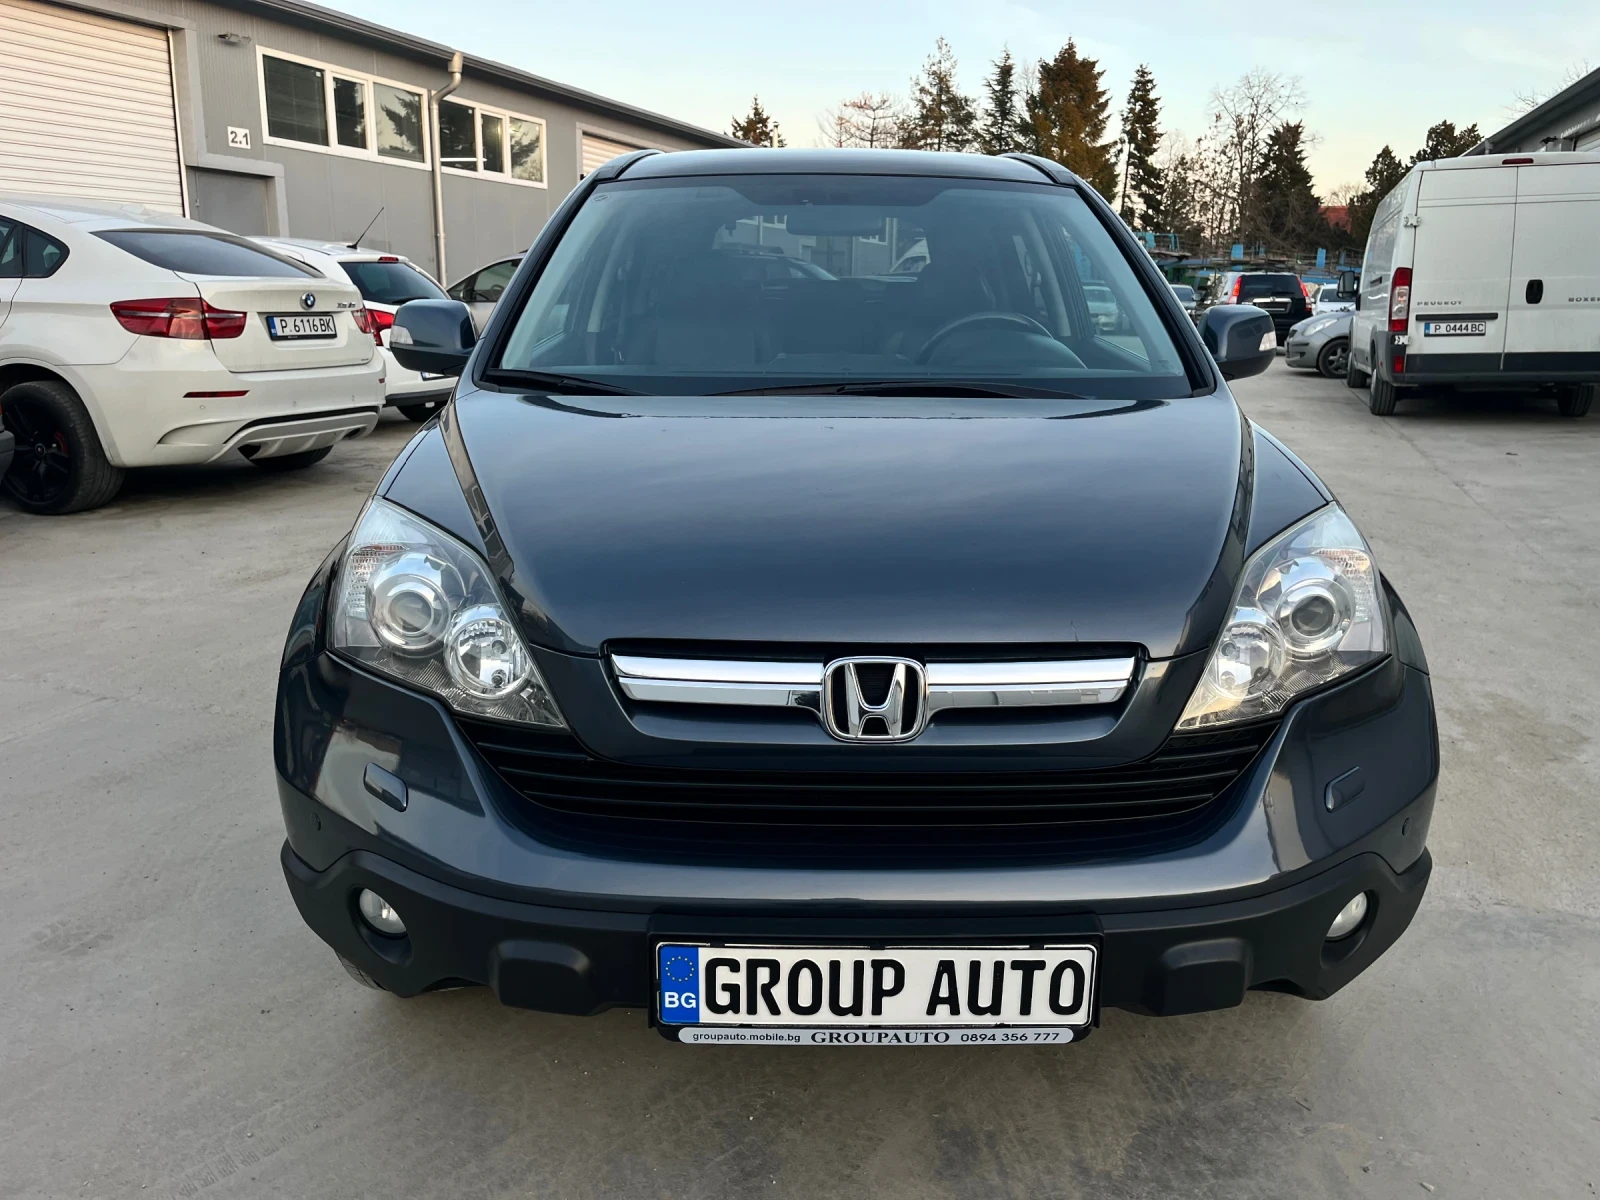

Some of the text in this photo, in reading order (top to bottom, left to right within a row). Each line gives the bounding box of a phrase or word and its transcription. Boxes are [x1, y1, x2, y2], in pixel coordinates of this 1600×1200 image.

[229, 130, 249, 146] 2.1
[704, 957, 1086, 1017] GROUP AUTO
[664, 992, 697, 1009] BG
[692, 1030, 1060, 1044] groupauto.mobile.bg GROUPAUTO 0894 356 777
